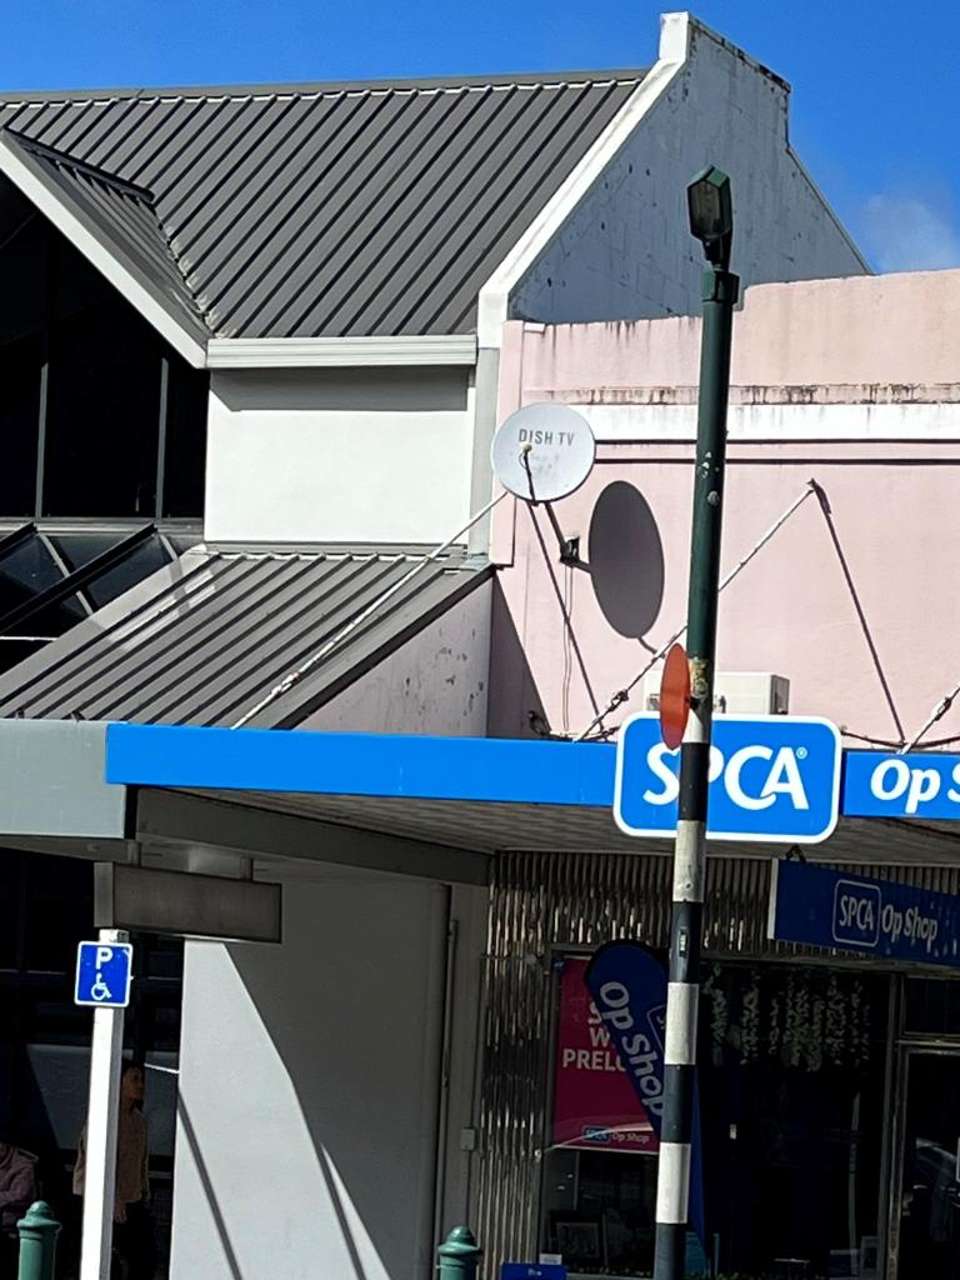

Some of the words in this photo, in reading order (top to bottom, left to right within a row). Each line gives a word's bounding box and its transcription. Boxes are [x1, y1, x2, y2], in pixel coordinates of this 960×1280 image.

[519, 428, 553, 445] DISH
[558, 432, 575, 446] TV
[870, 758, 941, 815] Op
[838, 895, 875, 931] SPCA
[881, 904, 901, 944] Op
[903, 906, 938, 953] Shop
[96, 946, 113, 970] P
[600, 981, 634, 1030] Op
